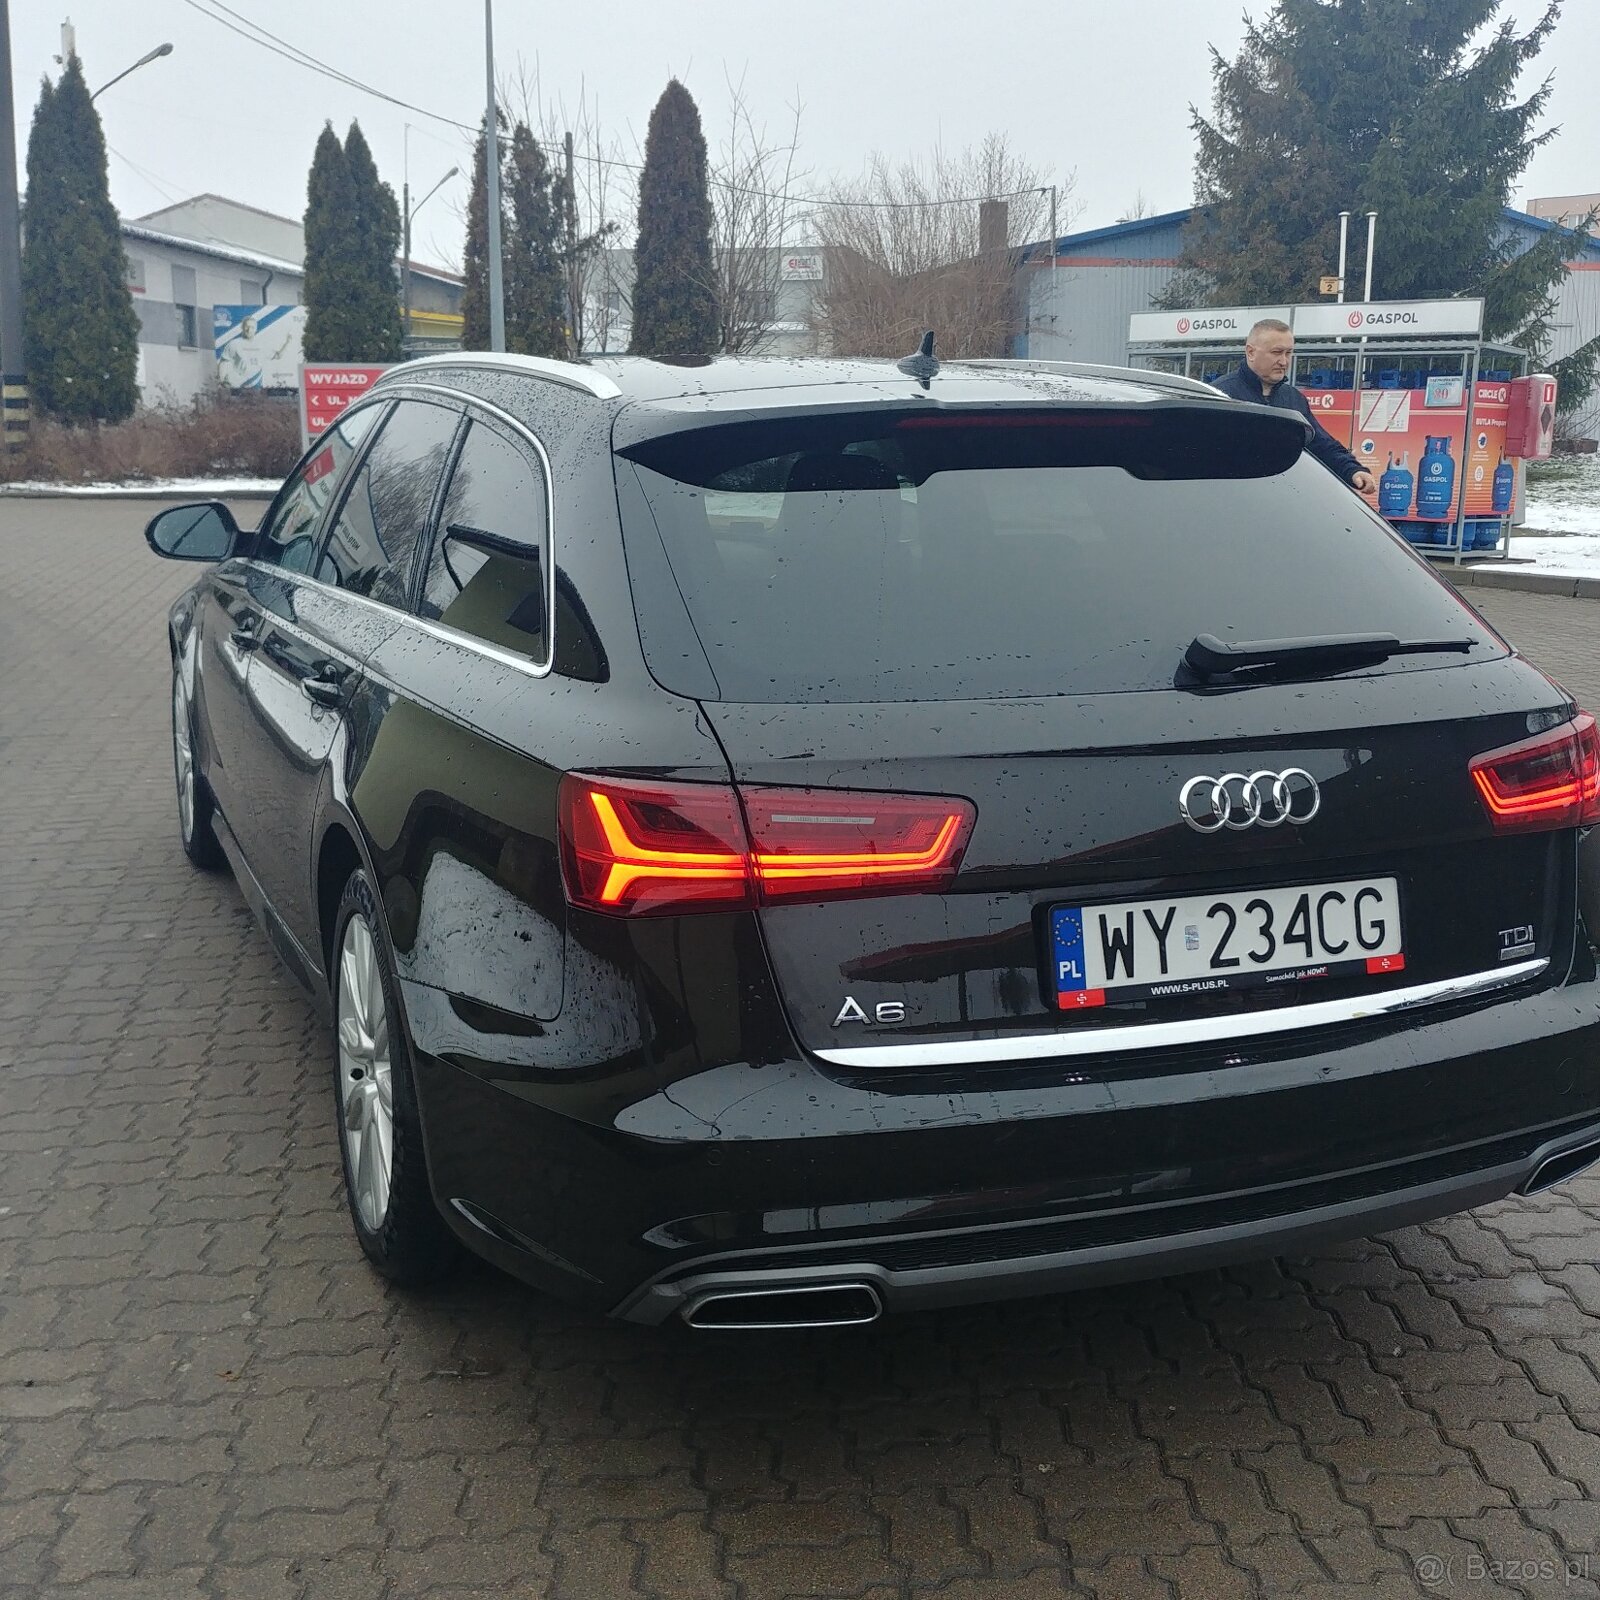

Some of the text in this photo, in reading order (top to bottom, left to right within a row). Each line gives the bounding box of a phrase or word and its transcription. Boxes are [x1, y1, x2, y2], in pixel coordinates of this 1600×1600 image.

[1327, 284, 1333, 292] 2
[1192, 318, 1238, 331] GASPOL
[1366, 312, 1419, 325] GASPOL
[309, 374, 369, 385] WYJAZD
[327, 395, 346, 405] UL.
[1478, 389, 1498, 399] CIRCLE
[1323, 395, 1333, 407] K
[1475, 418, 1491, 426] BUTLA
[1098, 886, 1386, 980] WY 234CG
[1498, 924, 1534, 946] TDI
[1059, 960, 1082, 980] PL
[1265, 966, 1326, 982] Samochód jak NOWY
[1150, 979, 1229, 996] WWW.S-PLUS.PL
[831, 996, 906, 1027] A6
